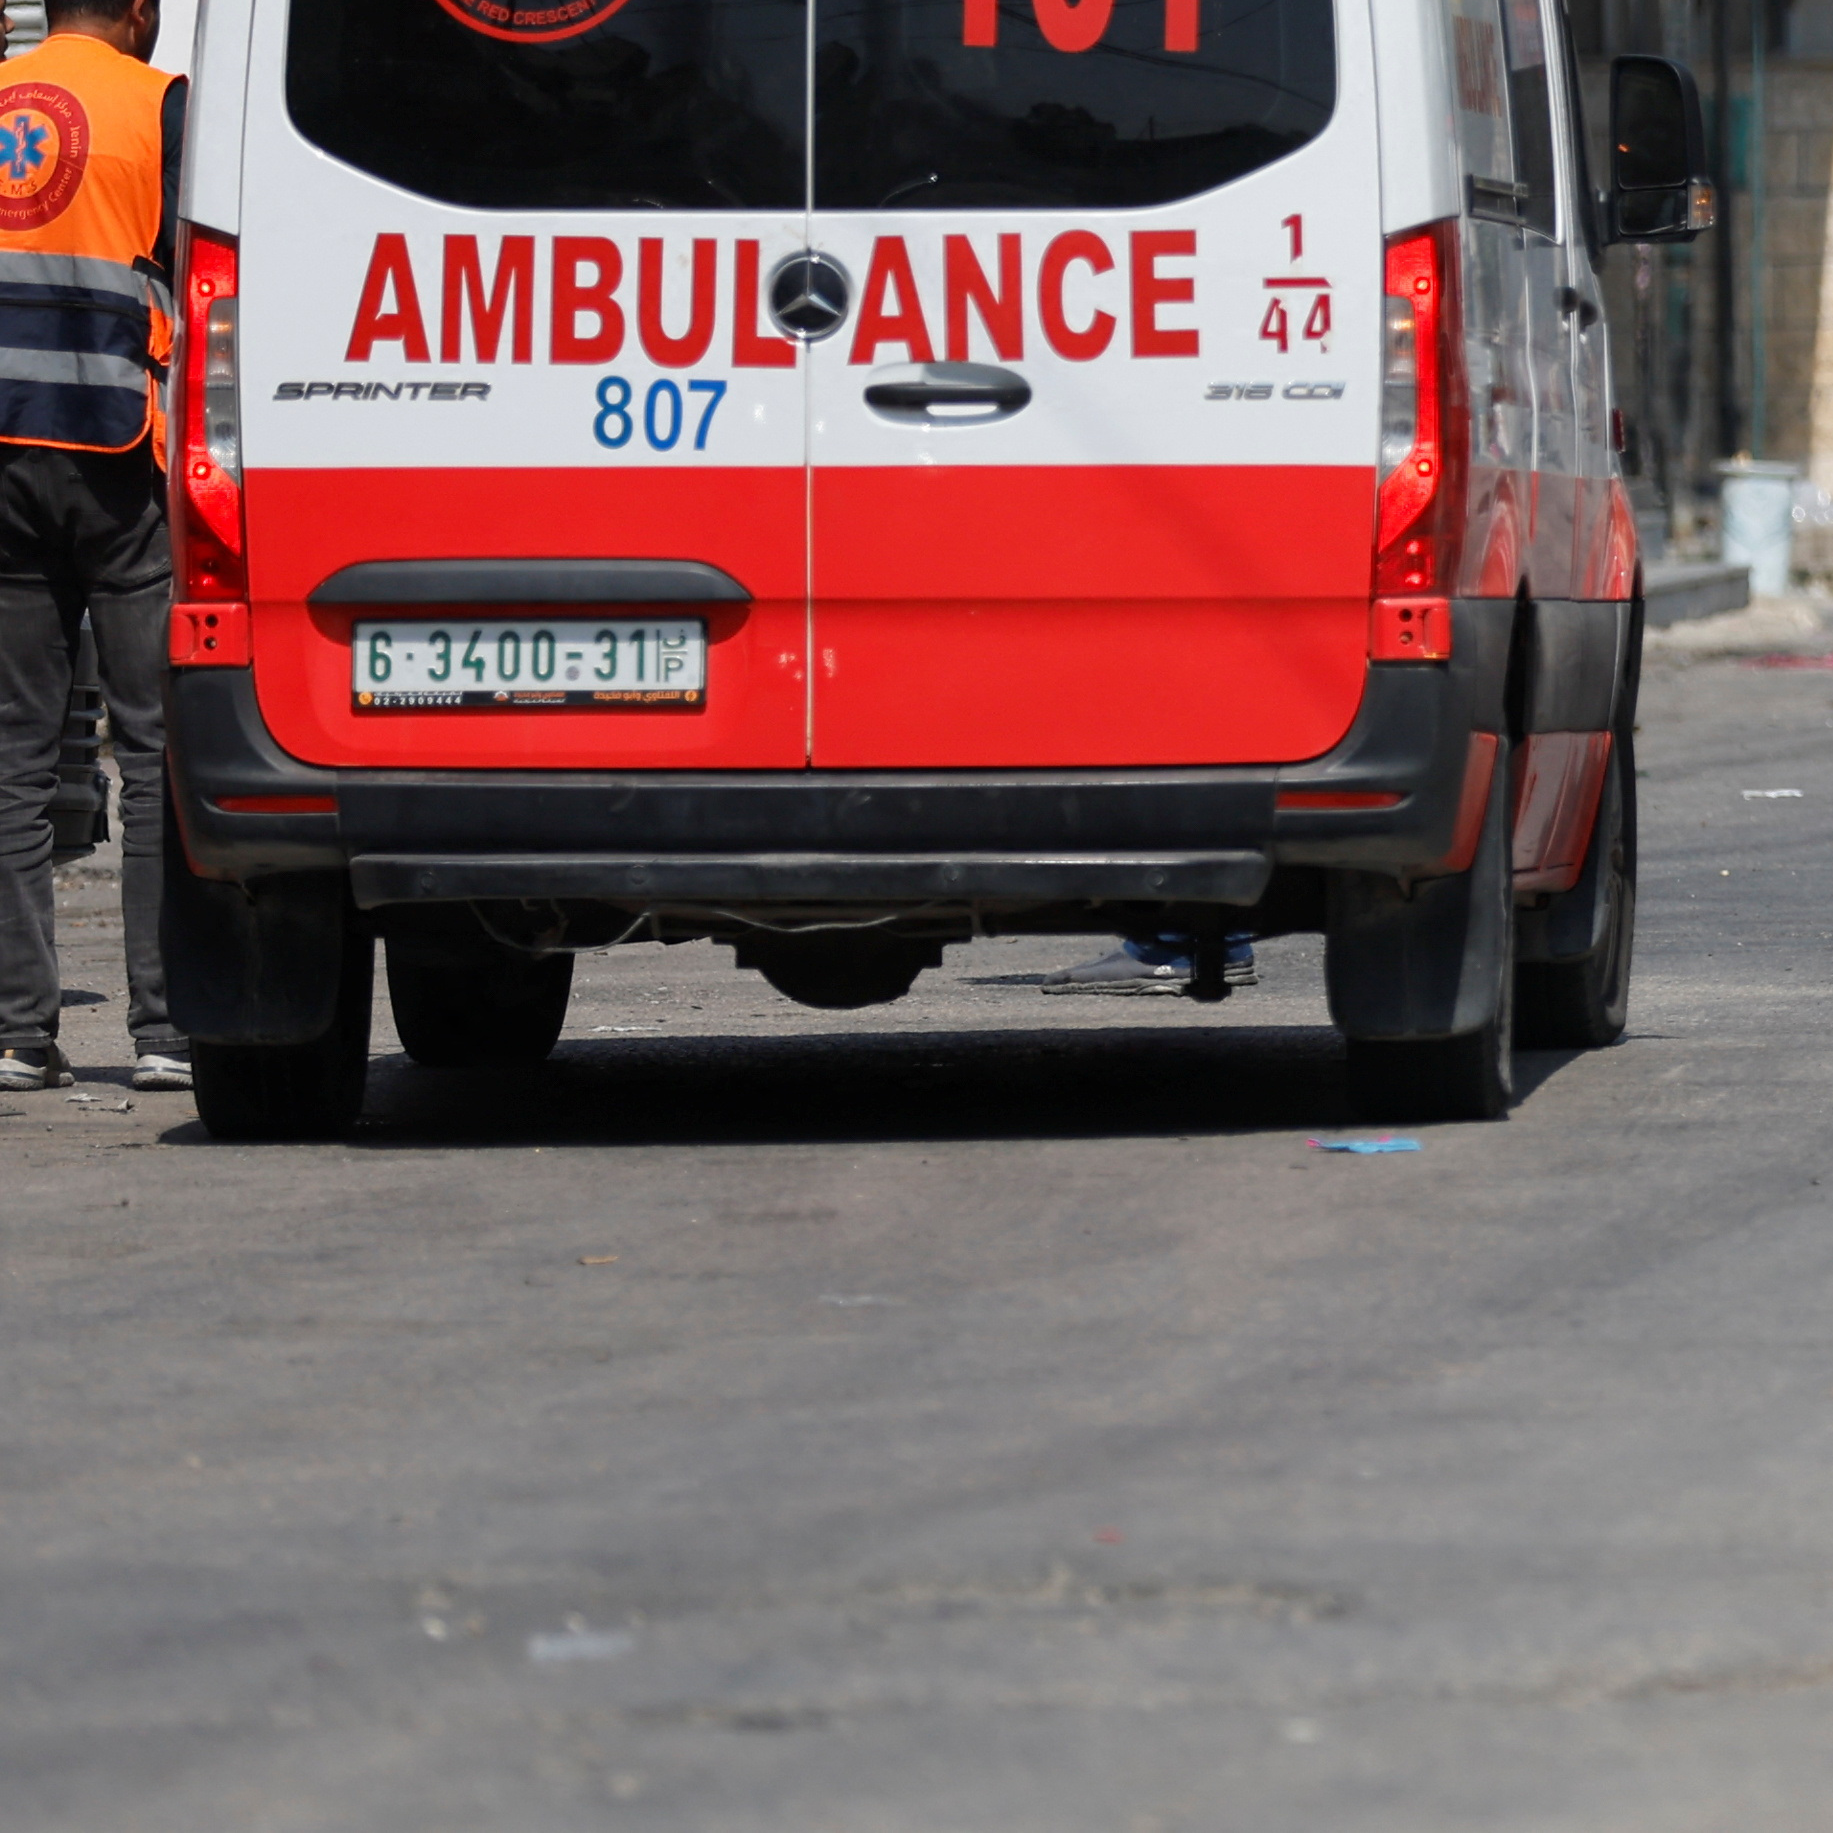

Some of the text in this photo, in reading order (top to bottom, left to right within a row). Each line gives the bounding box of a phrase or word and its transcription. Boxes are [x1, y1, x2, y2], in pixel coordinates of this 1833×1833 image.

[1281, 213, 1303, 264] 1
[272, 381, 492, 402] SPRINTER
[1281, 380, 1347, 401] CDI
[592, 375, 728, 453] 807
[664, 656, 685, 683] P
